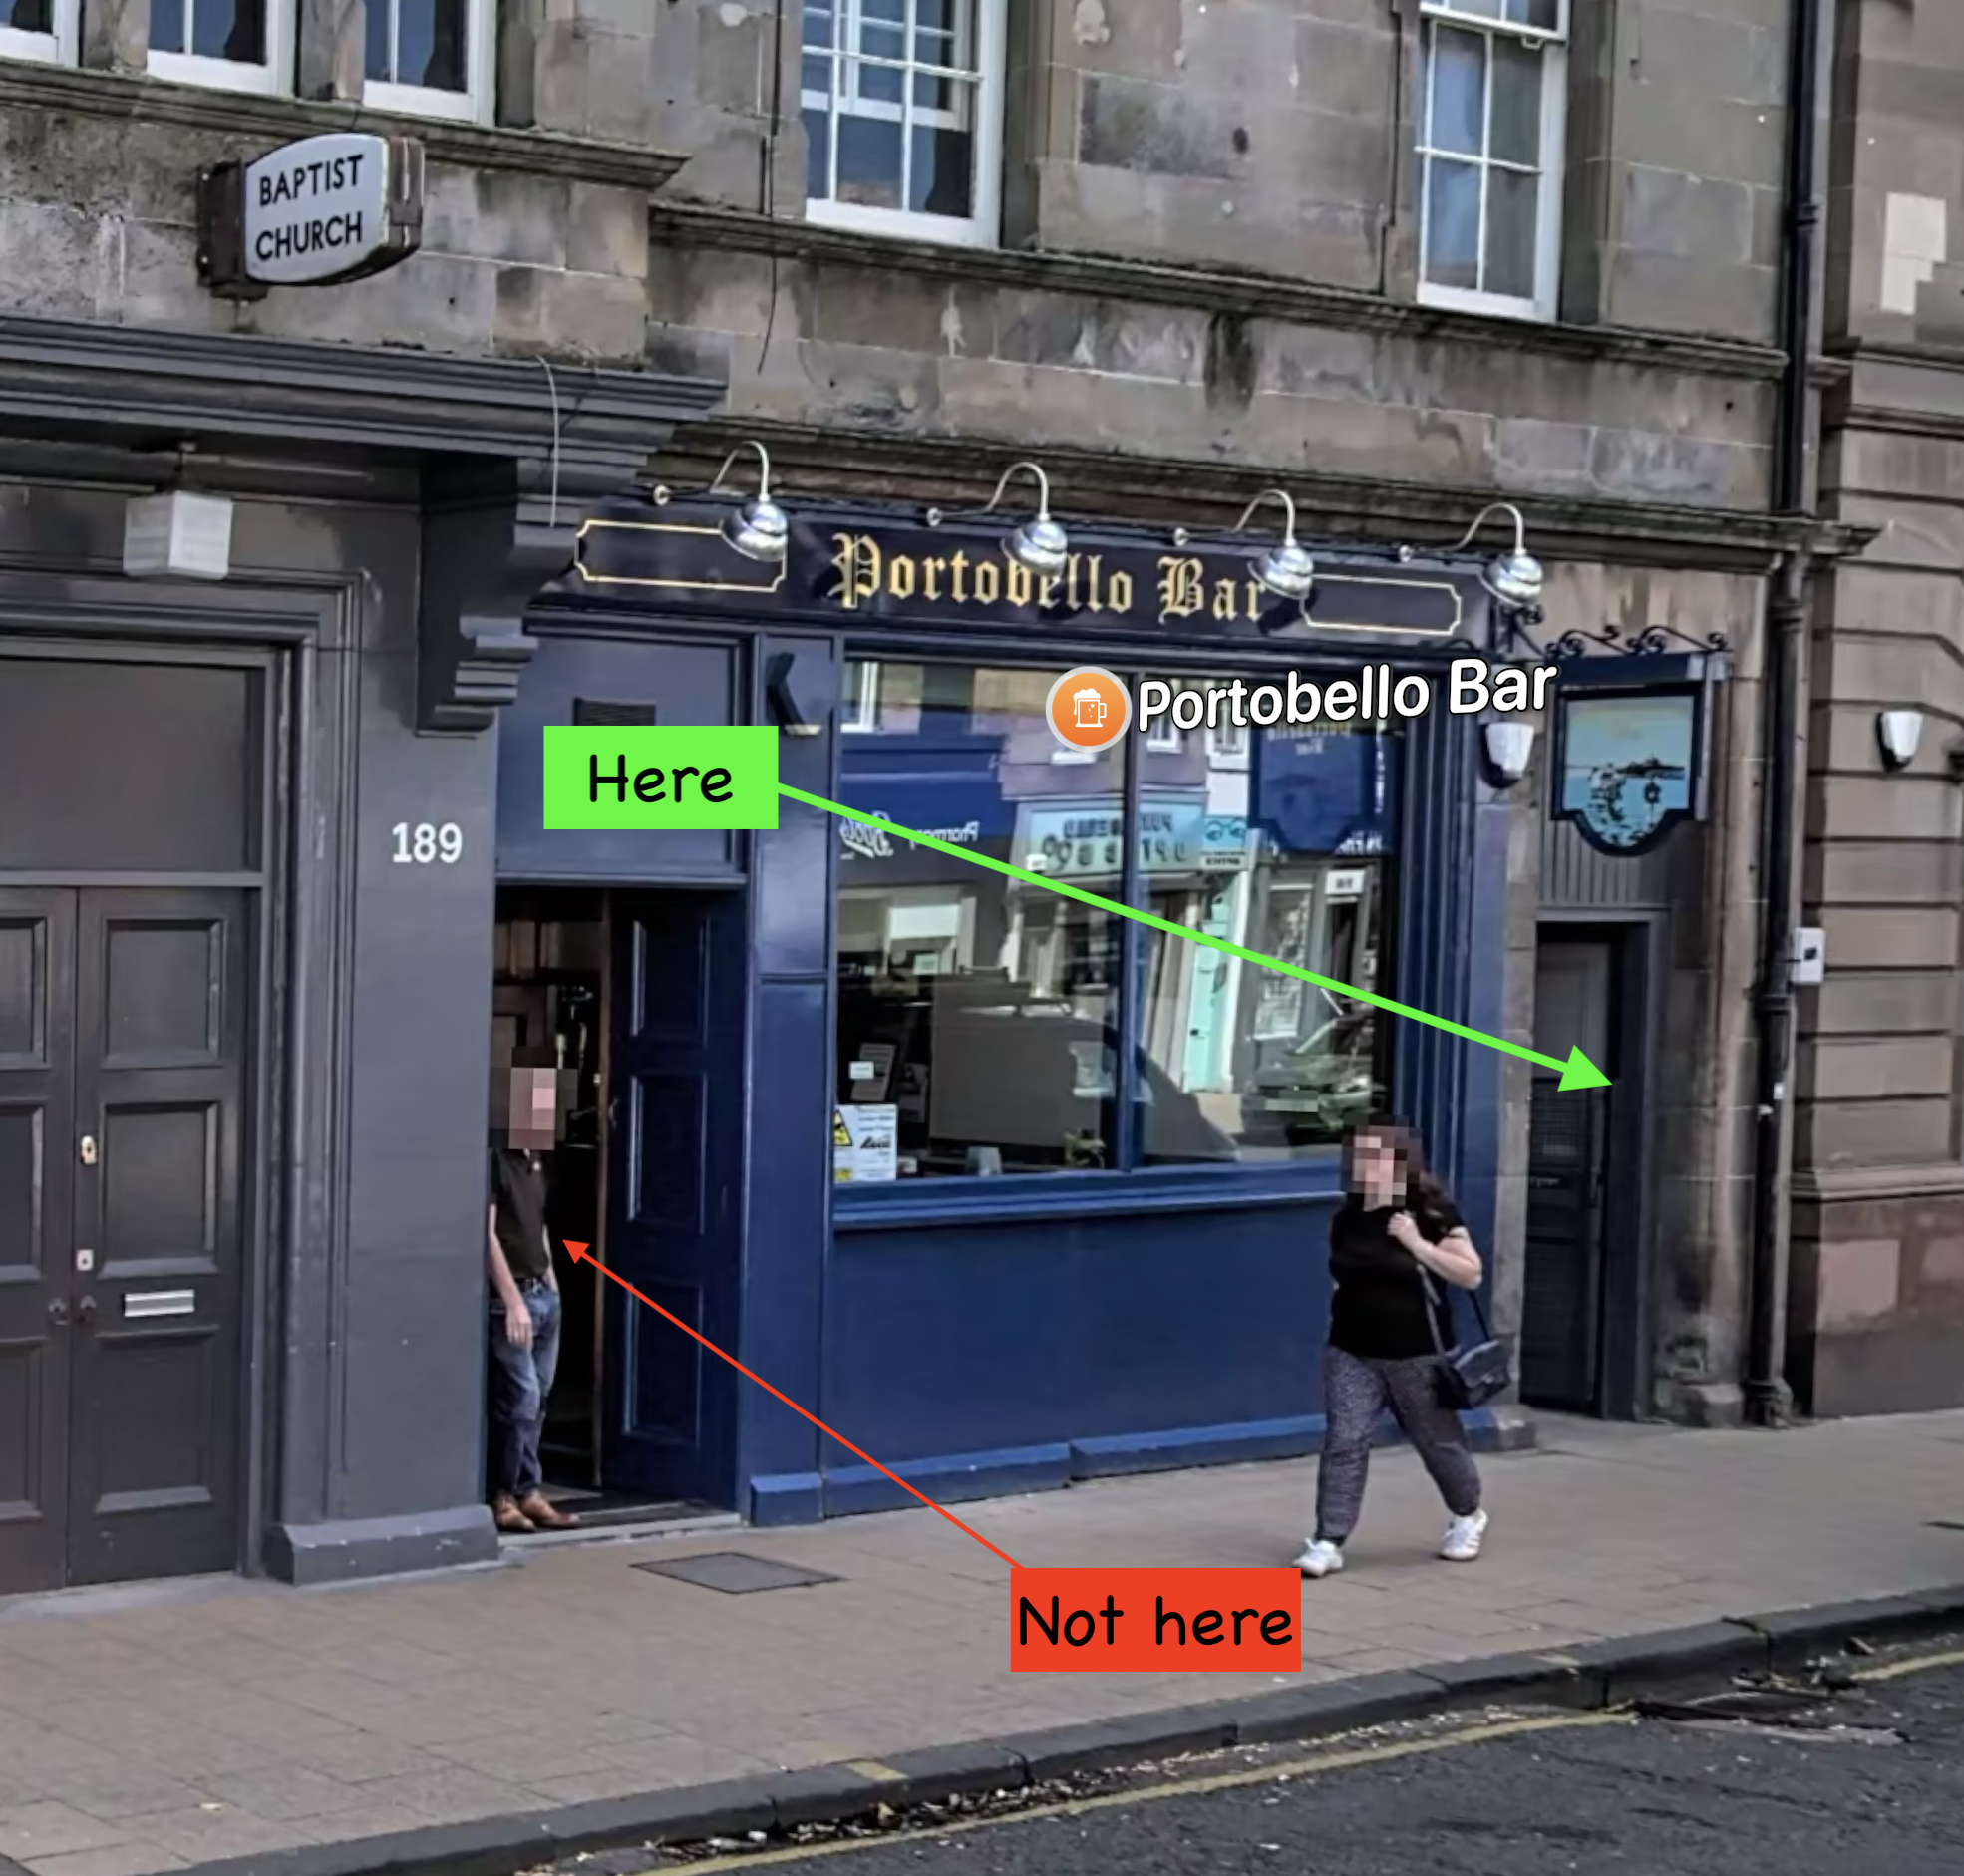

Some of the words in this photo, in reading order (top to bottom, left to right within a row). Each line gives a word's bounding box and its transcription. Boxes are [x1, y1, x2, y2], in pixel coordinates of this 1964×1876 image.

[258, 155, 364, 207] BAPTIST
[255, 211, 363, 261] CHURCH
[828, 532, 1134, 612] Portobello
[1156, 555, 1266, 625] Bar
[392, 822, 463, 864] 189
